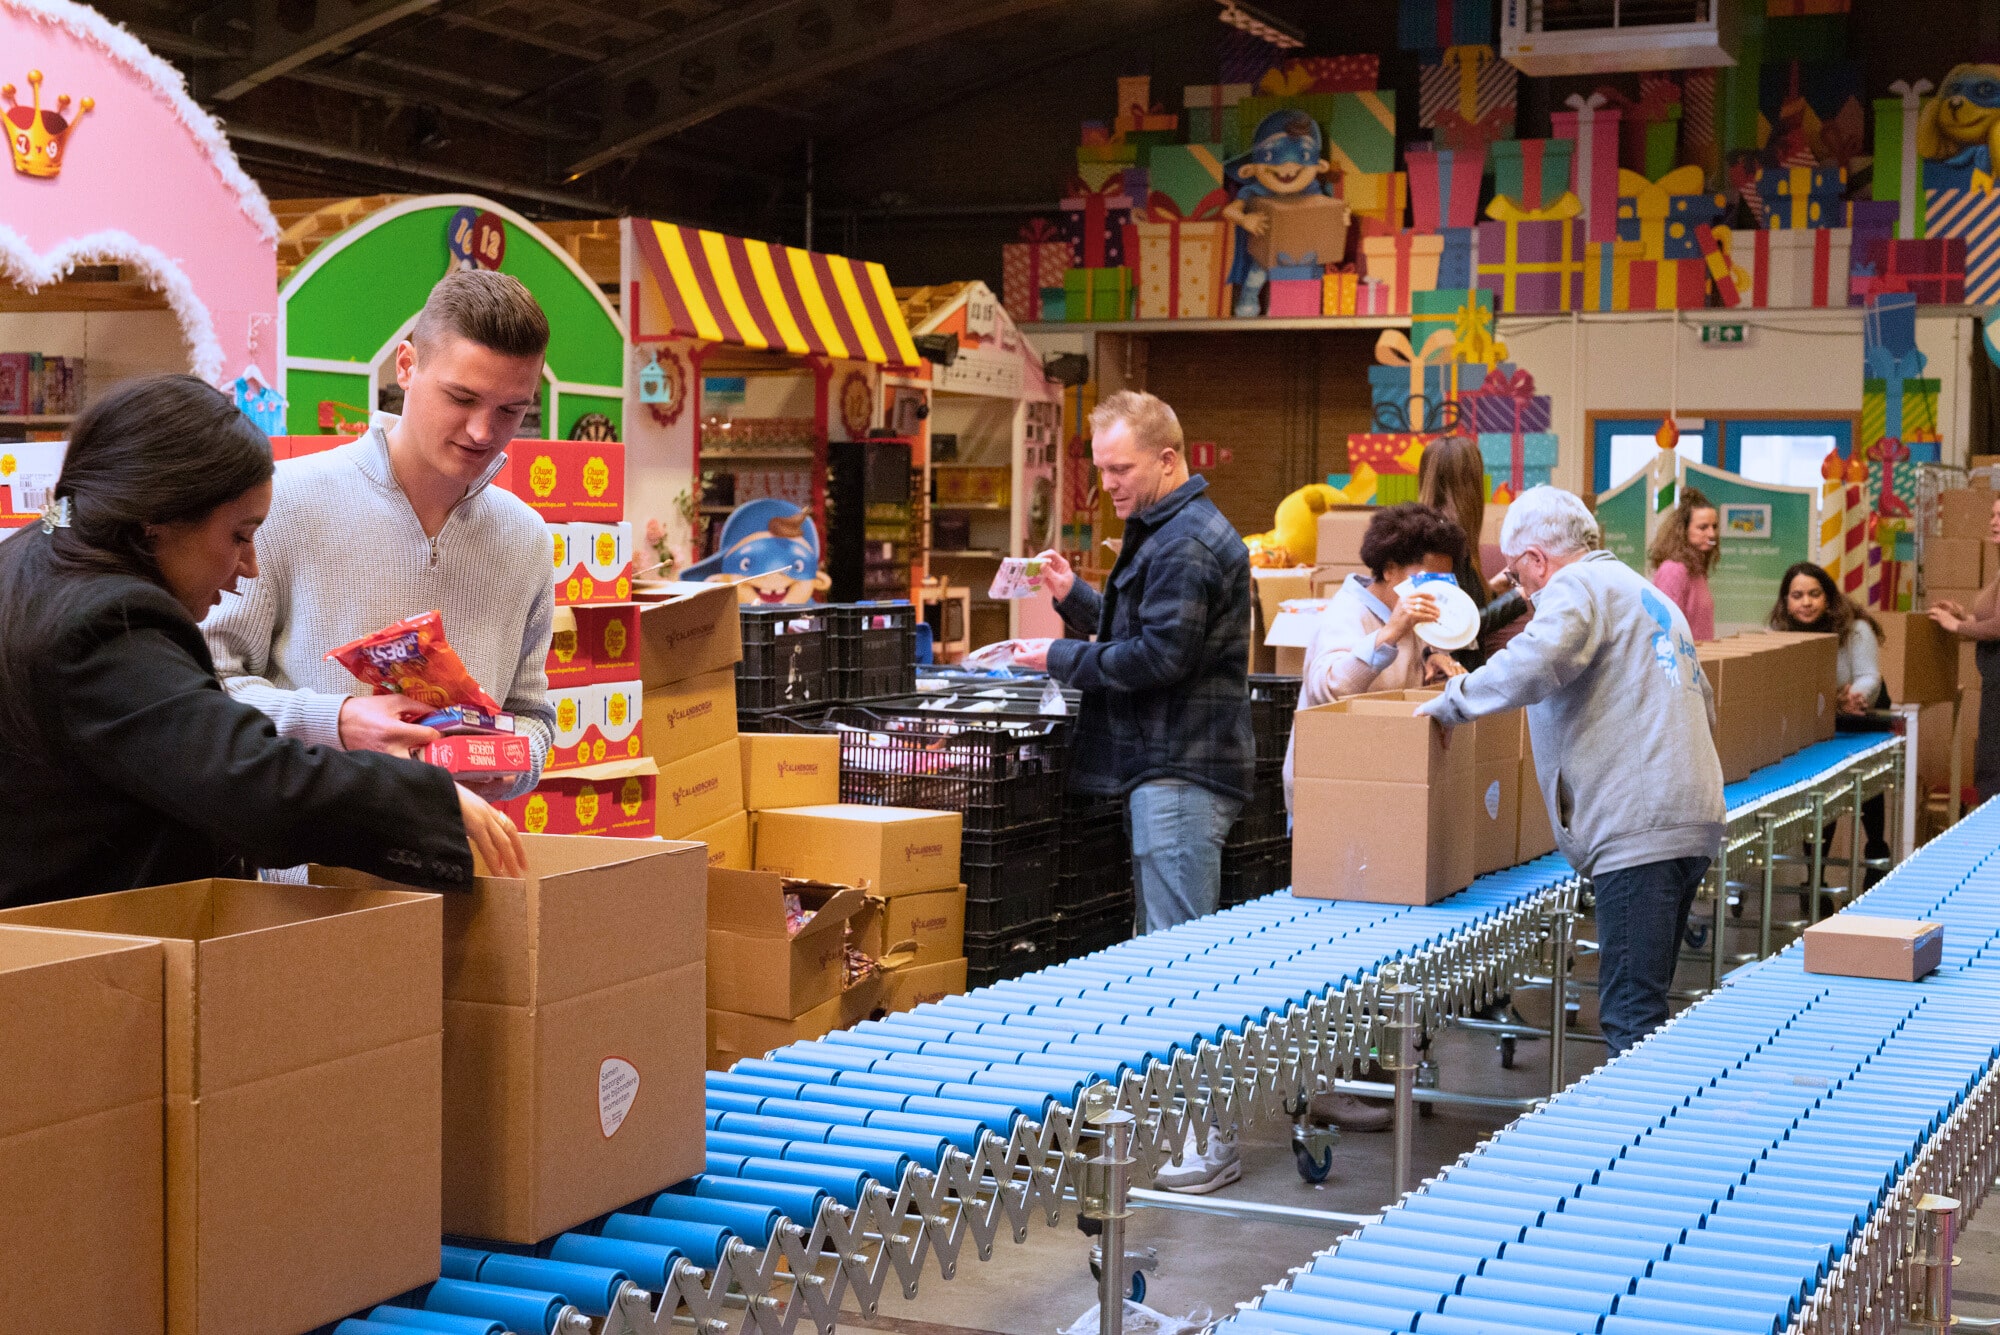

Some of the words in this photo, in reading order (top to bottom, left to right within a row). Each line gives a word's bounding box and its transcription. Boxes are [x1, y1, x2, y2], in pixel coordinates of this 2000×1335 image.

[480, 224, 501, 260] 12
[534, 466, 553, 475] Chupa
[587, 467, 605, 476] Chupa
[533, 476, 551, 488] Chups
[586, 476, 604, 488] Chups
[468, 744, 495, 756] KOEKEN
[601, 1067, 618, 1081] Samen
[601, 1073, 626, 1092] bezorgen
[611, 1077, 636, 1098] bijzondere
[603, 1092, 629, 1112] momenten
